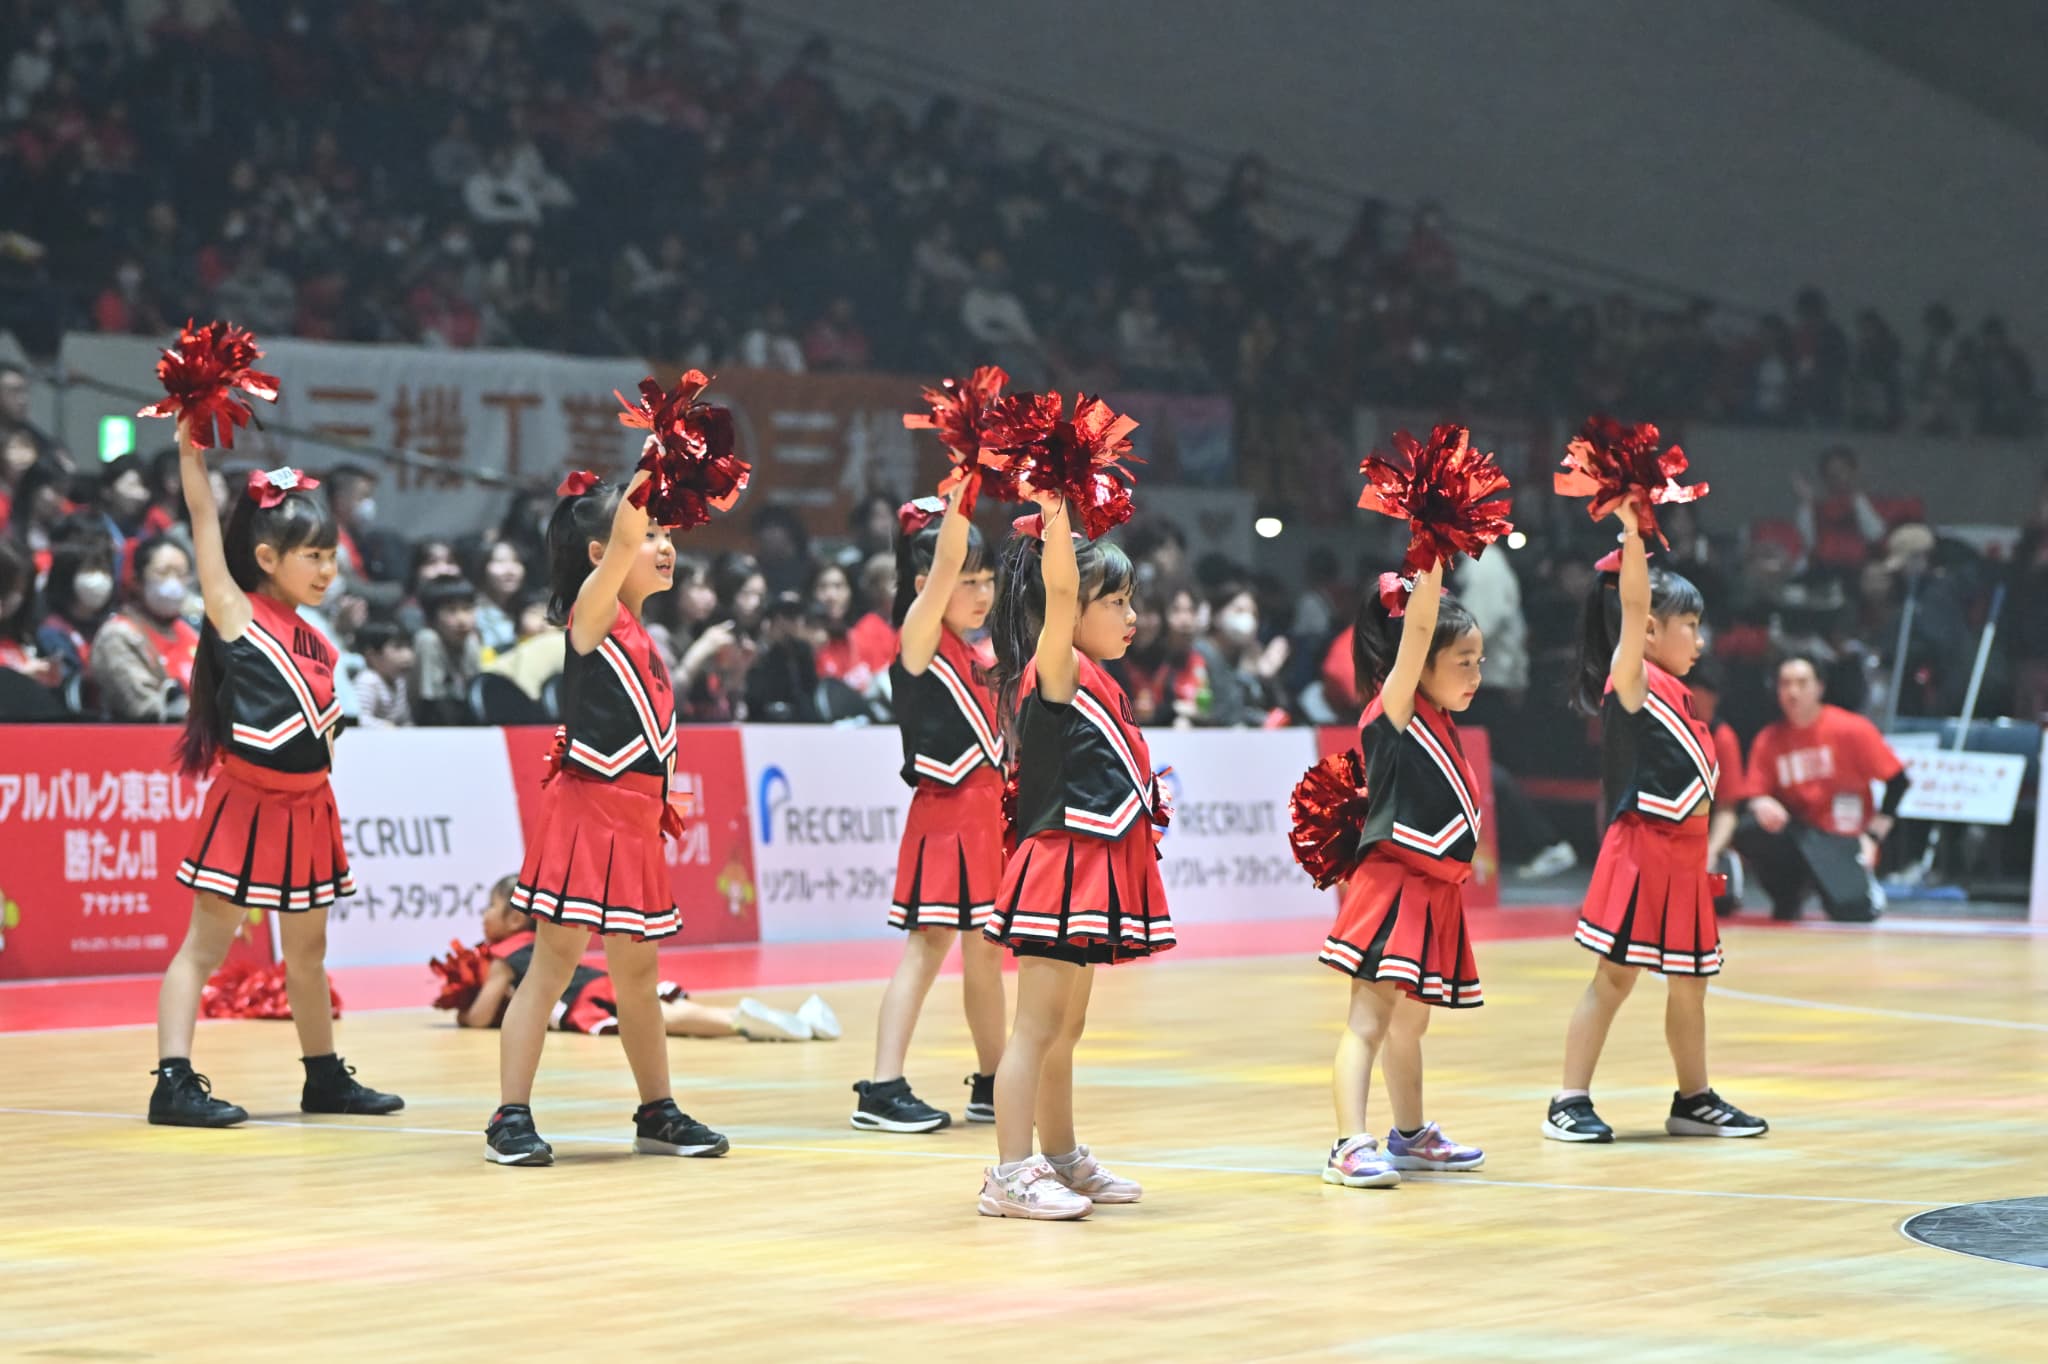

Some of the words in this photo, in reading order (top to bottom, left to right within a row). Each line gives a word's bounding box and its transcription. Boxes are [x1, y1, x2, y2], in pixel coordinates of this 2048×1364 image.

[340, 814, 453, 858] ECRUIT
[785, 806, 898, 844] RECRUIT
[1178, 801, 1277, 837] RECRUIT
